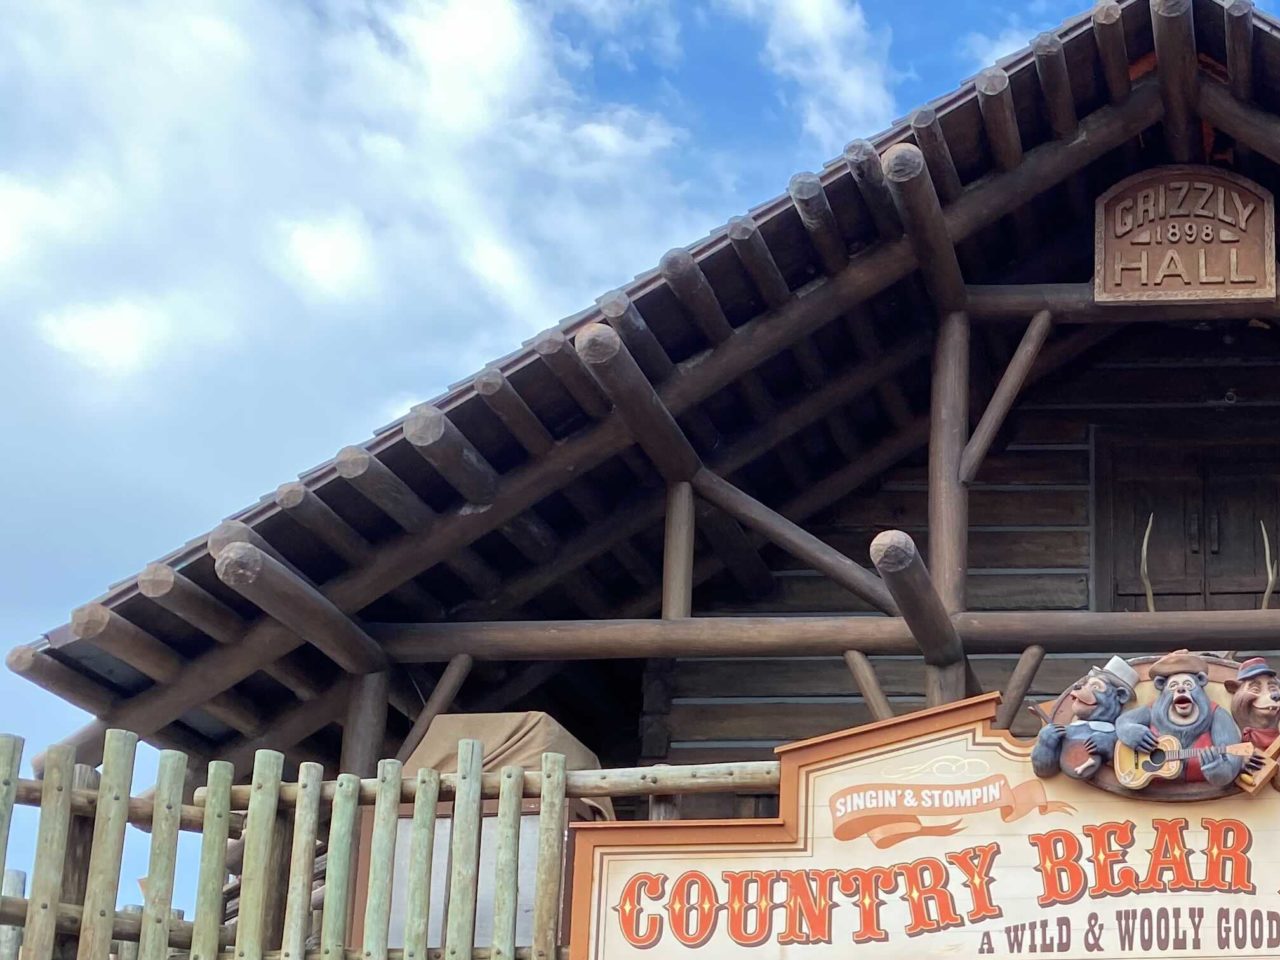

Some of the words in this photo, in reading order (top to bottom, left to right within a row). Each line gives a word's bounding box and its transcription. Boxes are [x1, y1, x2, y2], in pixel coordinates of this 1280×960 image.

[1114, 181, 1257, 239] GRIZZLY
[1155, 222, 1215, 245] 1898
[1114, 248, 1257, 286] HALL
[835, 789, 902, 817] SINGIN'
[903, 789, 918, 808] &
[920, 780, 1006, 808] STOMPIN'
[617, 841, 1004, 950] COUNTRY
[1030, 817, 1258, 910] BEAR
[978, 930, 995, 955] A
[1004, 915, 1072, 954] WILD
[1083, 911, 1104, 952] &
[1115, 907, 1204, 952] WOOLY
